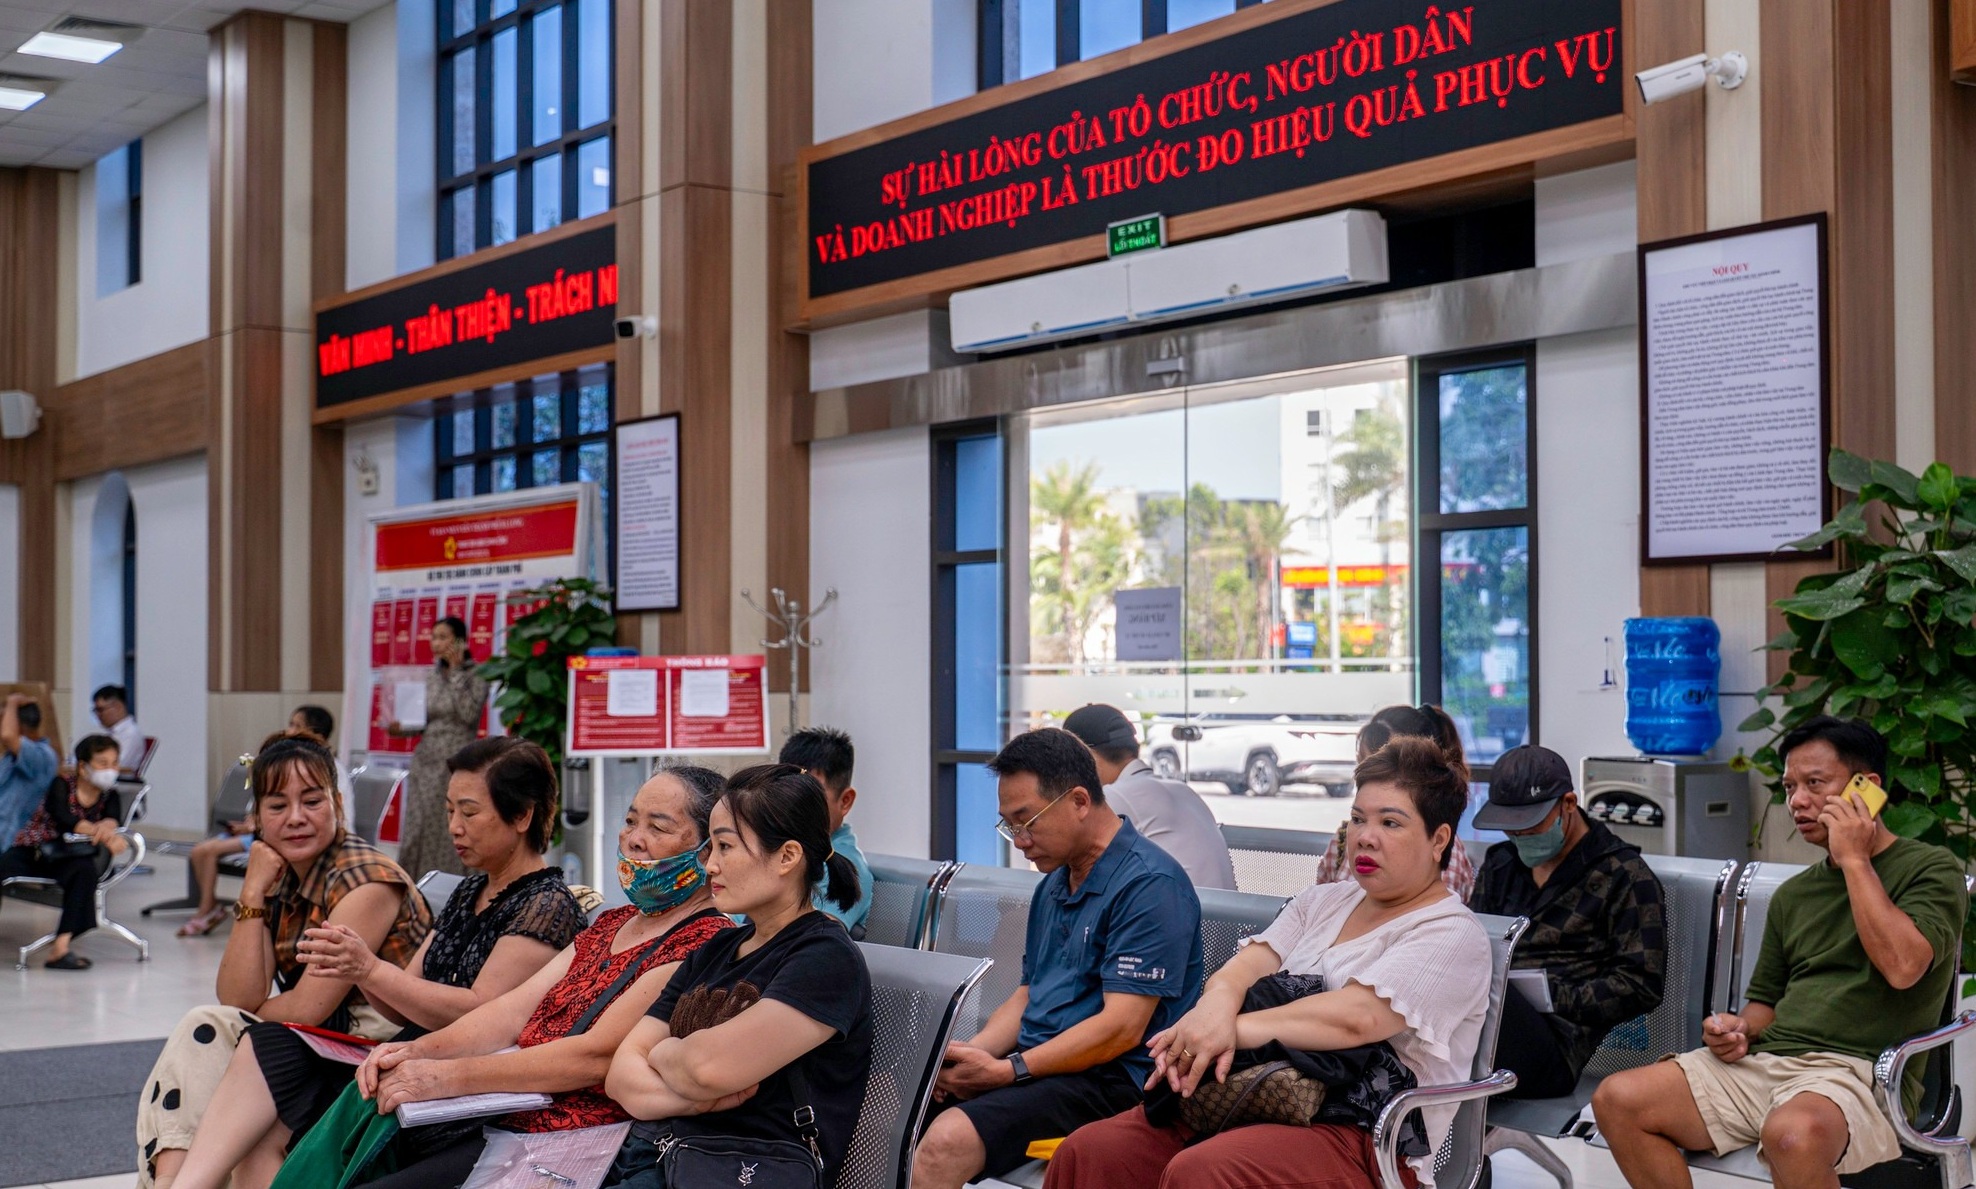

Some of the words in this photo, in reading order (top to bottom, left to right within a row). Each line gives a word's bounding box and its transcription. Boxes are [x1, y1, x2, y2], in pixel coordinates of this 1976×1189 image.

[815, 223, 848, 265] VÀ
[850, 206, 935, 258] DOANH
[938, 181, 1038, 237] NGHIỆP
[1040, 163, 1079, 212] LÀ
[1081, 139, 1191, 201] THƯỚC
[1196, 128, 1245, 173] ĐO
[1250, 102, 1336, 160] HIỆU
[1343, 68, 1427, 139] QUẢ
[1433, 46, 1547, 113] PHỤC
[1554, 26, 1617, 85] VỤ
[881, 161, 916, 209] SỰ
[917, 149, 964, 197] HÀI
[968, 133, 1043, 183] LÒNG
[1046, 110, 1107, 160] CỦA
[1108, 93, 1153, 144] TỔ
[1157, 71, 1259, 130] CHỨC,
[1265, 29, 1385, 102] NGƯỜI
[1393, 5, 1475, 66] DÂN
[1117, 220, 1152, 236] EXIT
[405, 303, 453, 355] THÂN
[453, 287, 511, 344] THIỆN
[525, 267, 594, 325] TRÁCH
